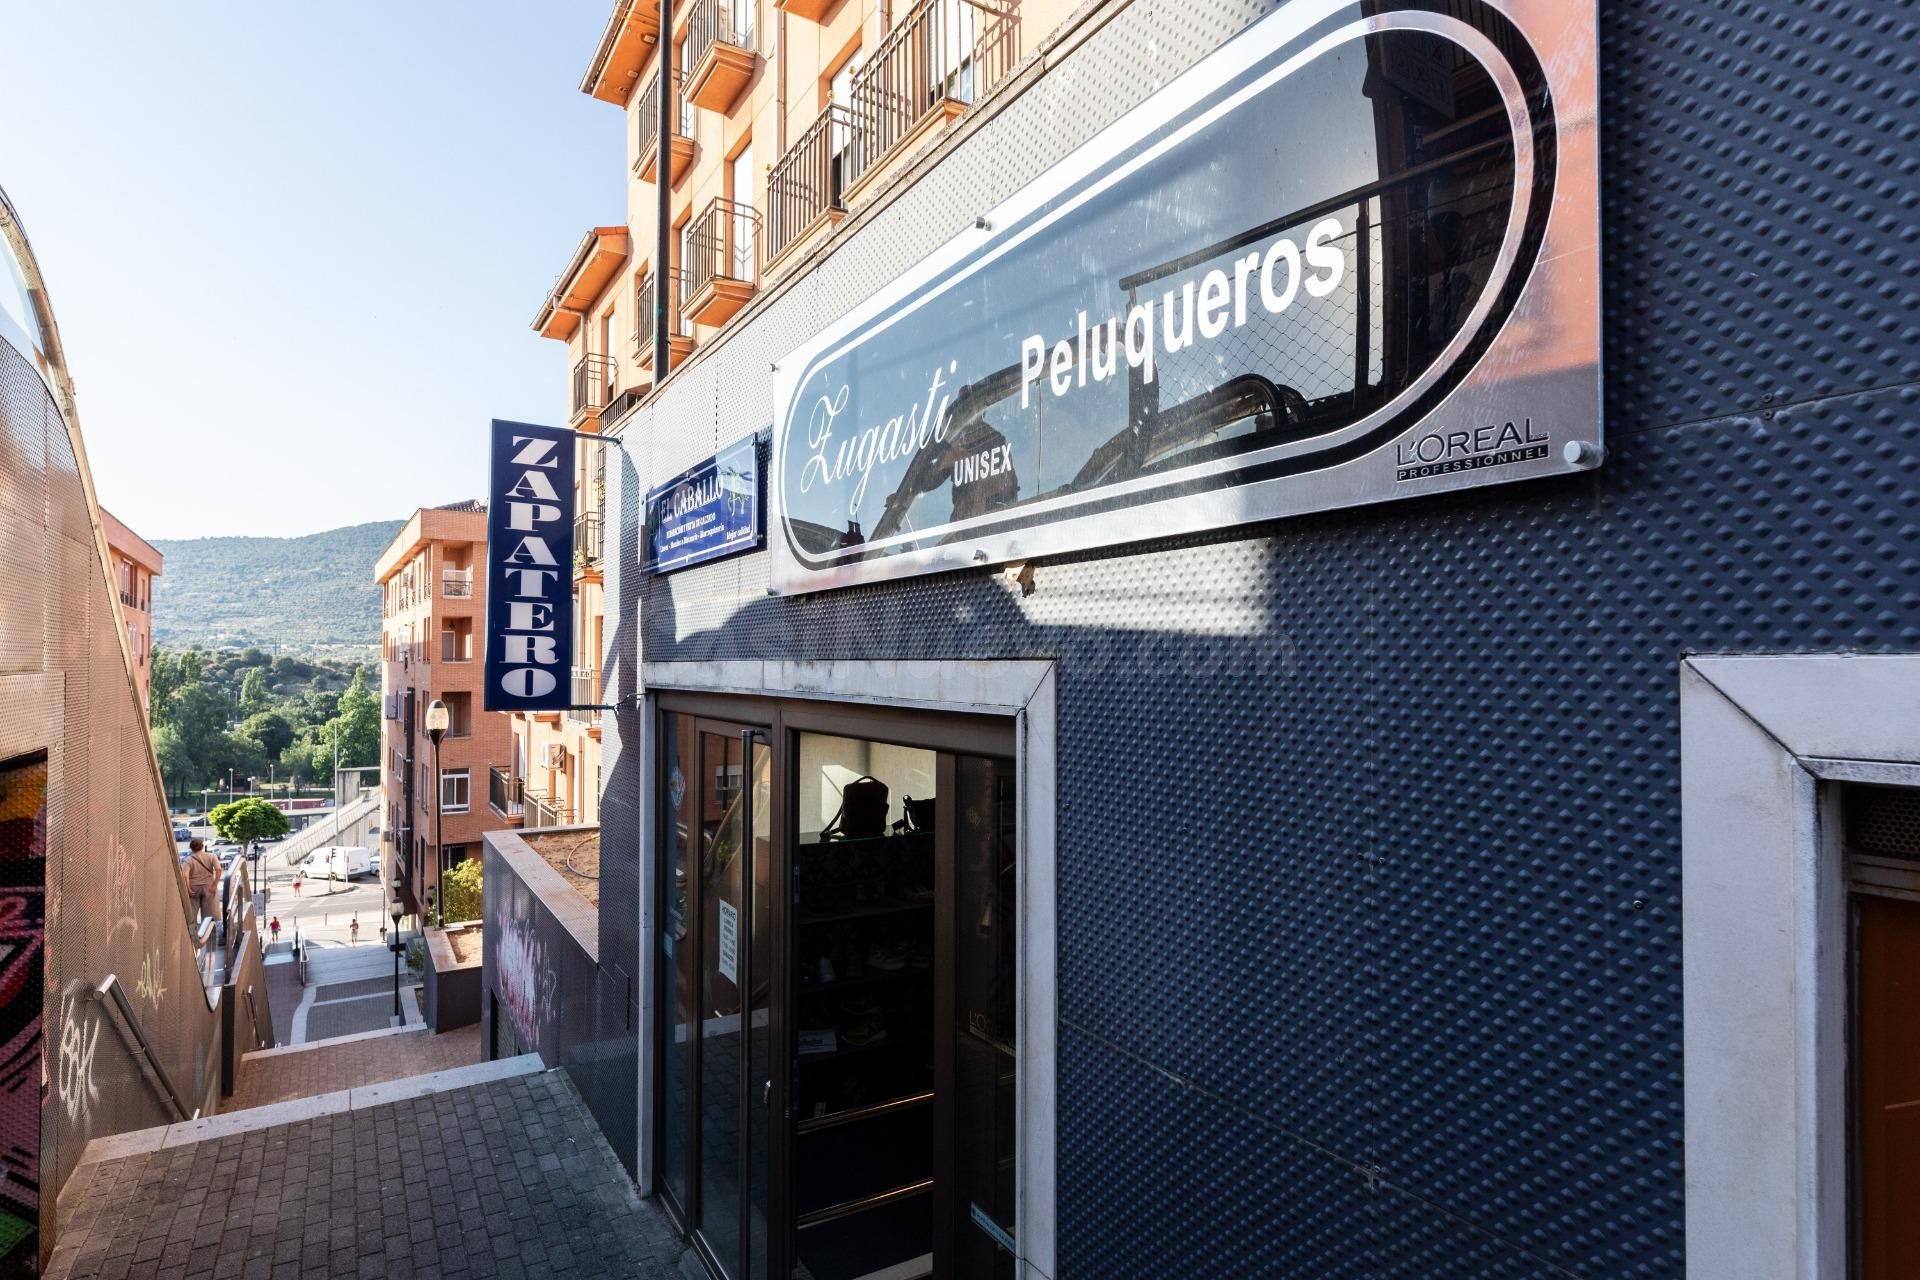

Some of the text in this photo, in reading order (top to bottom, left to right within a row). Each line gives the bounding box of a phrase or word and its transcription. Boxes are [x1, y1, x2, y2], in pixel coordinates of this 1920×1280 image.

[1020, 217, 1345, 410] Peluqueros
[800, 359, 957, 516] Zugasti
[954, 442, 1012, 487] UNISEX
[1398, 446, 1549, 481] PROFESSIONNEL
[661, 475, 724, 524] EL CABALLO
[499, 435, 562, 698] ZAPATERO
